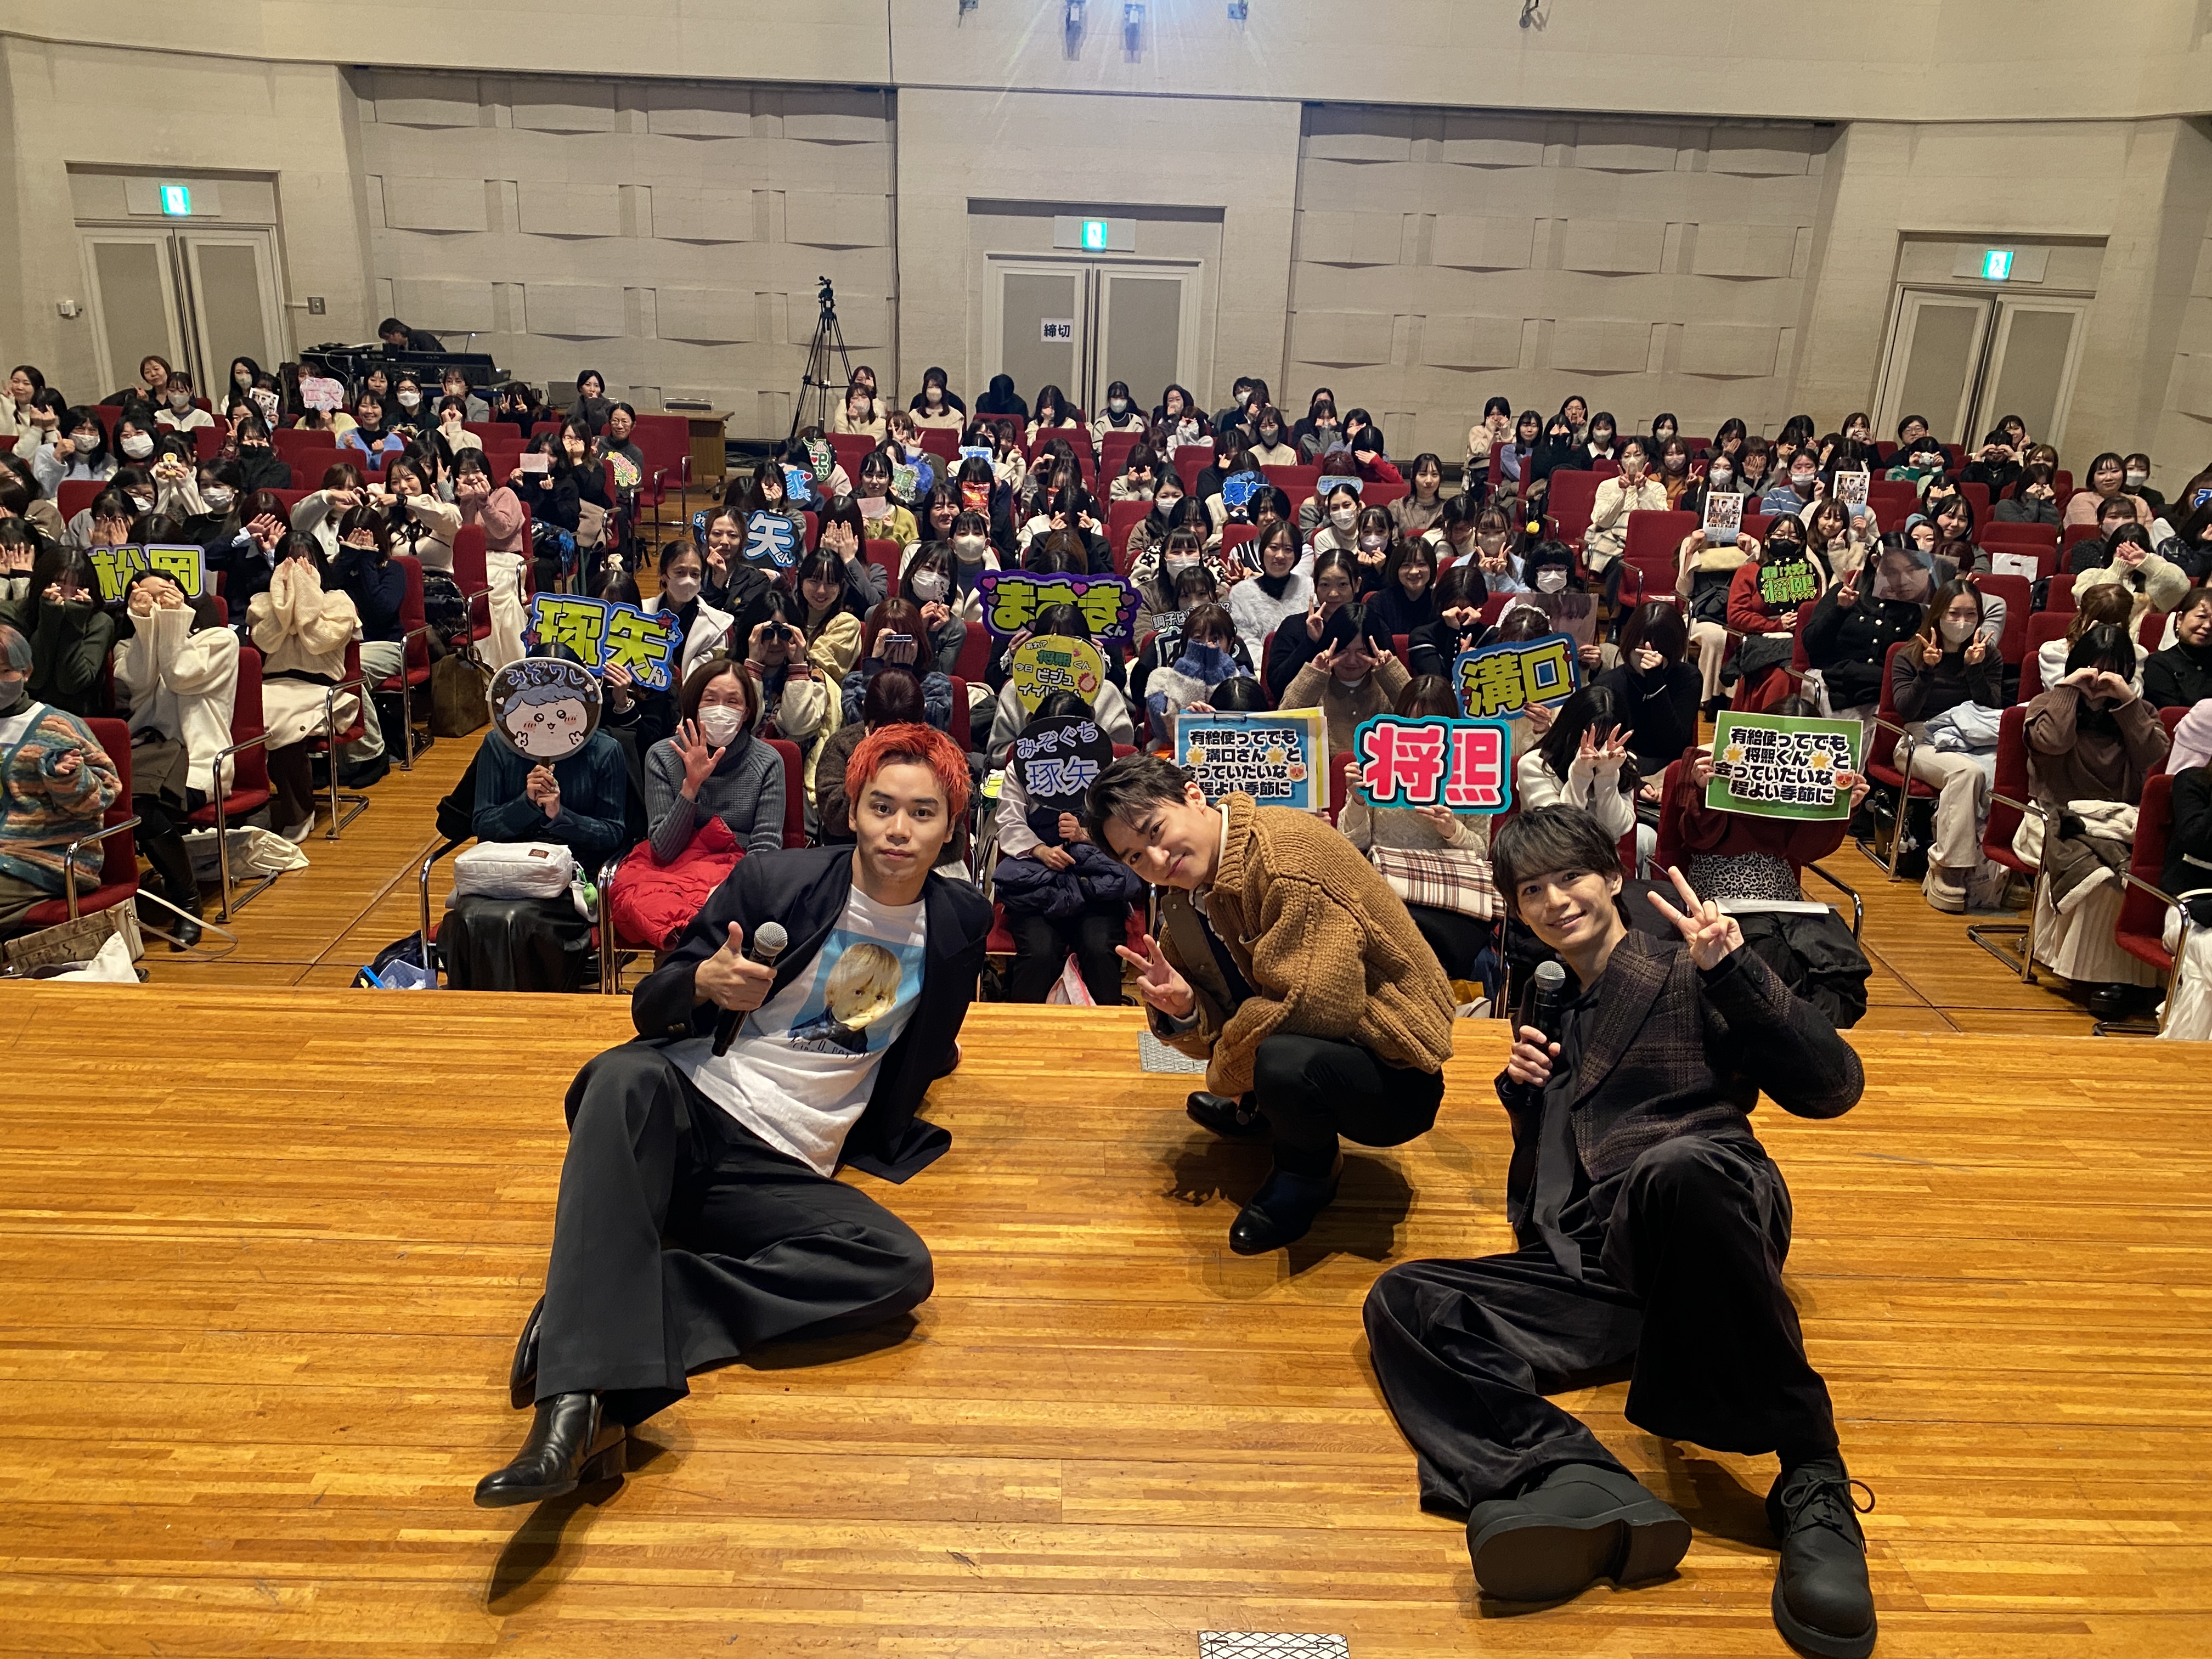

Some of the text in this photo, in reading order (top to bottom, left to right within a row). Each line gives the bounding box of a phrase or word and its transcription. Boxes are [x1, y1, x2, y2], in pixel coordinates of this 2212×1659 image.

[1044, 324, 1070, 337] 締切
[746, 512, 794, 565] 矢くん
[90, 549, 200, 600] 松岡
[1015, 663, 1075, 686] 今日 ビジュ
[1463, 643, 1572, 716] 溝口
[1017, 721, 1099, 759] みぞぐち
[1189, 730, 1298, 745] 有給使ってでも
[1730, 727, 1848, 752] 有給使ってでも
[1025, 755, 1101, 797] 琢矢
[1714, 761, 1833, 786] 会っていたいな
[1730, 779, 1835, 804] 程よい季節に
